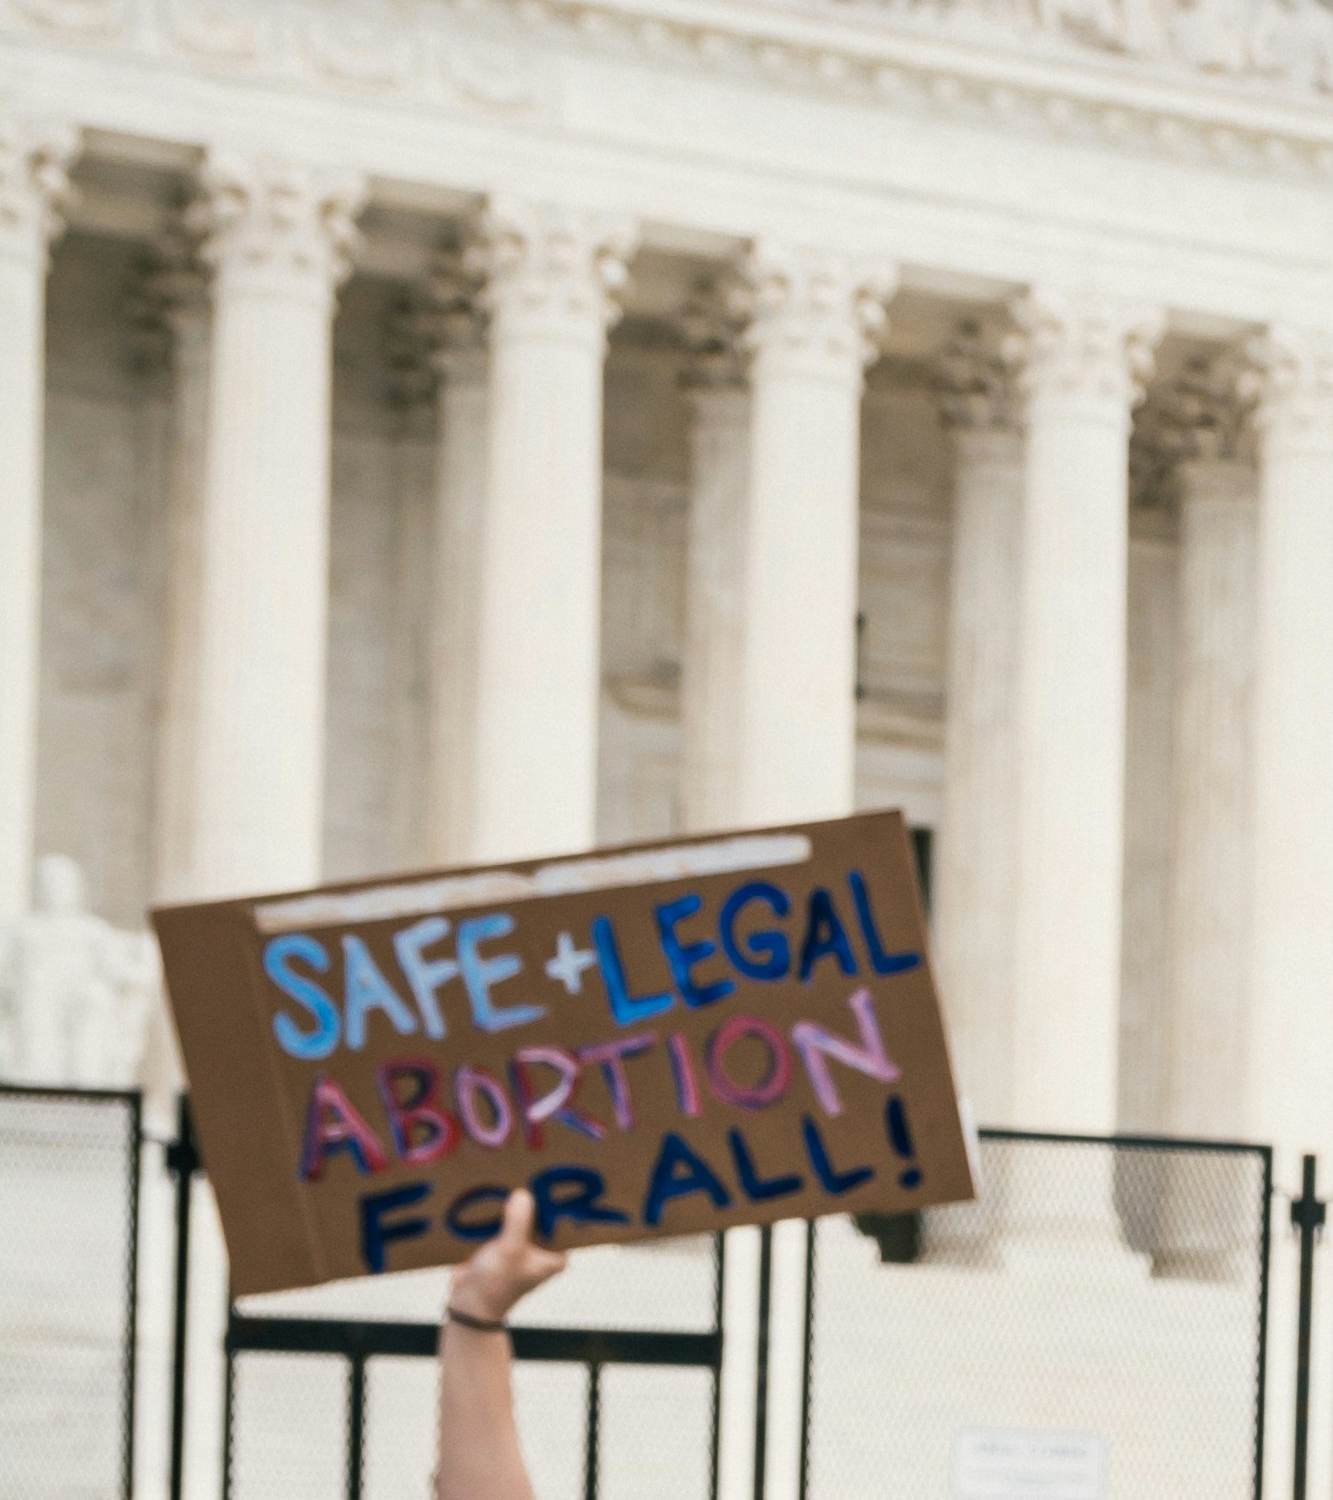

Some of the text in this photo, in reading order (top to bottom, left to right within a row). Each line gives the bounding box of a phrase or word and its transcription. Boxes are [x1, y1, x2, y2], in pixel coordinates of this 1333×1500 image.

[262, 912, 546, 1060] SAFE
[590, 869, 922, 1026] LEGAL
[300, 988, 904, 1182] ABORTION
[358, 1093, 926, 1274] FOR ALL!
